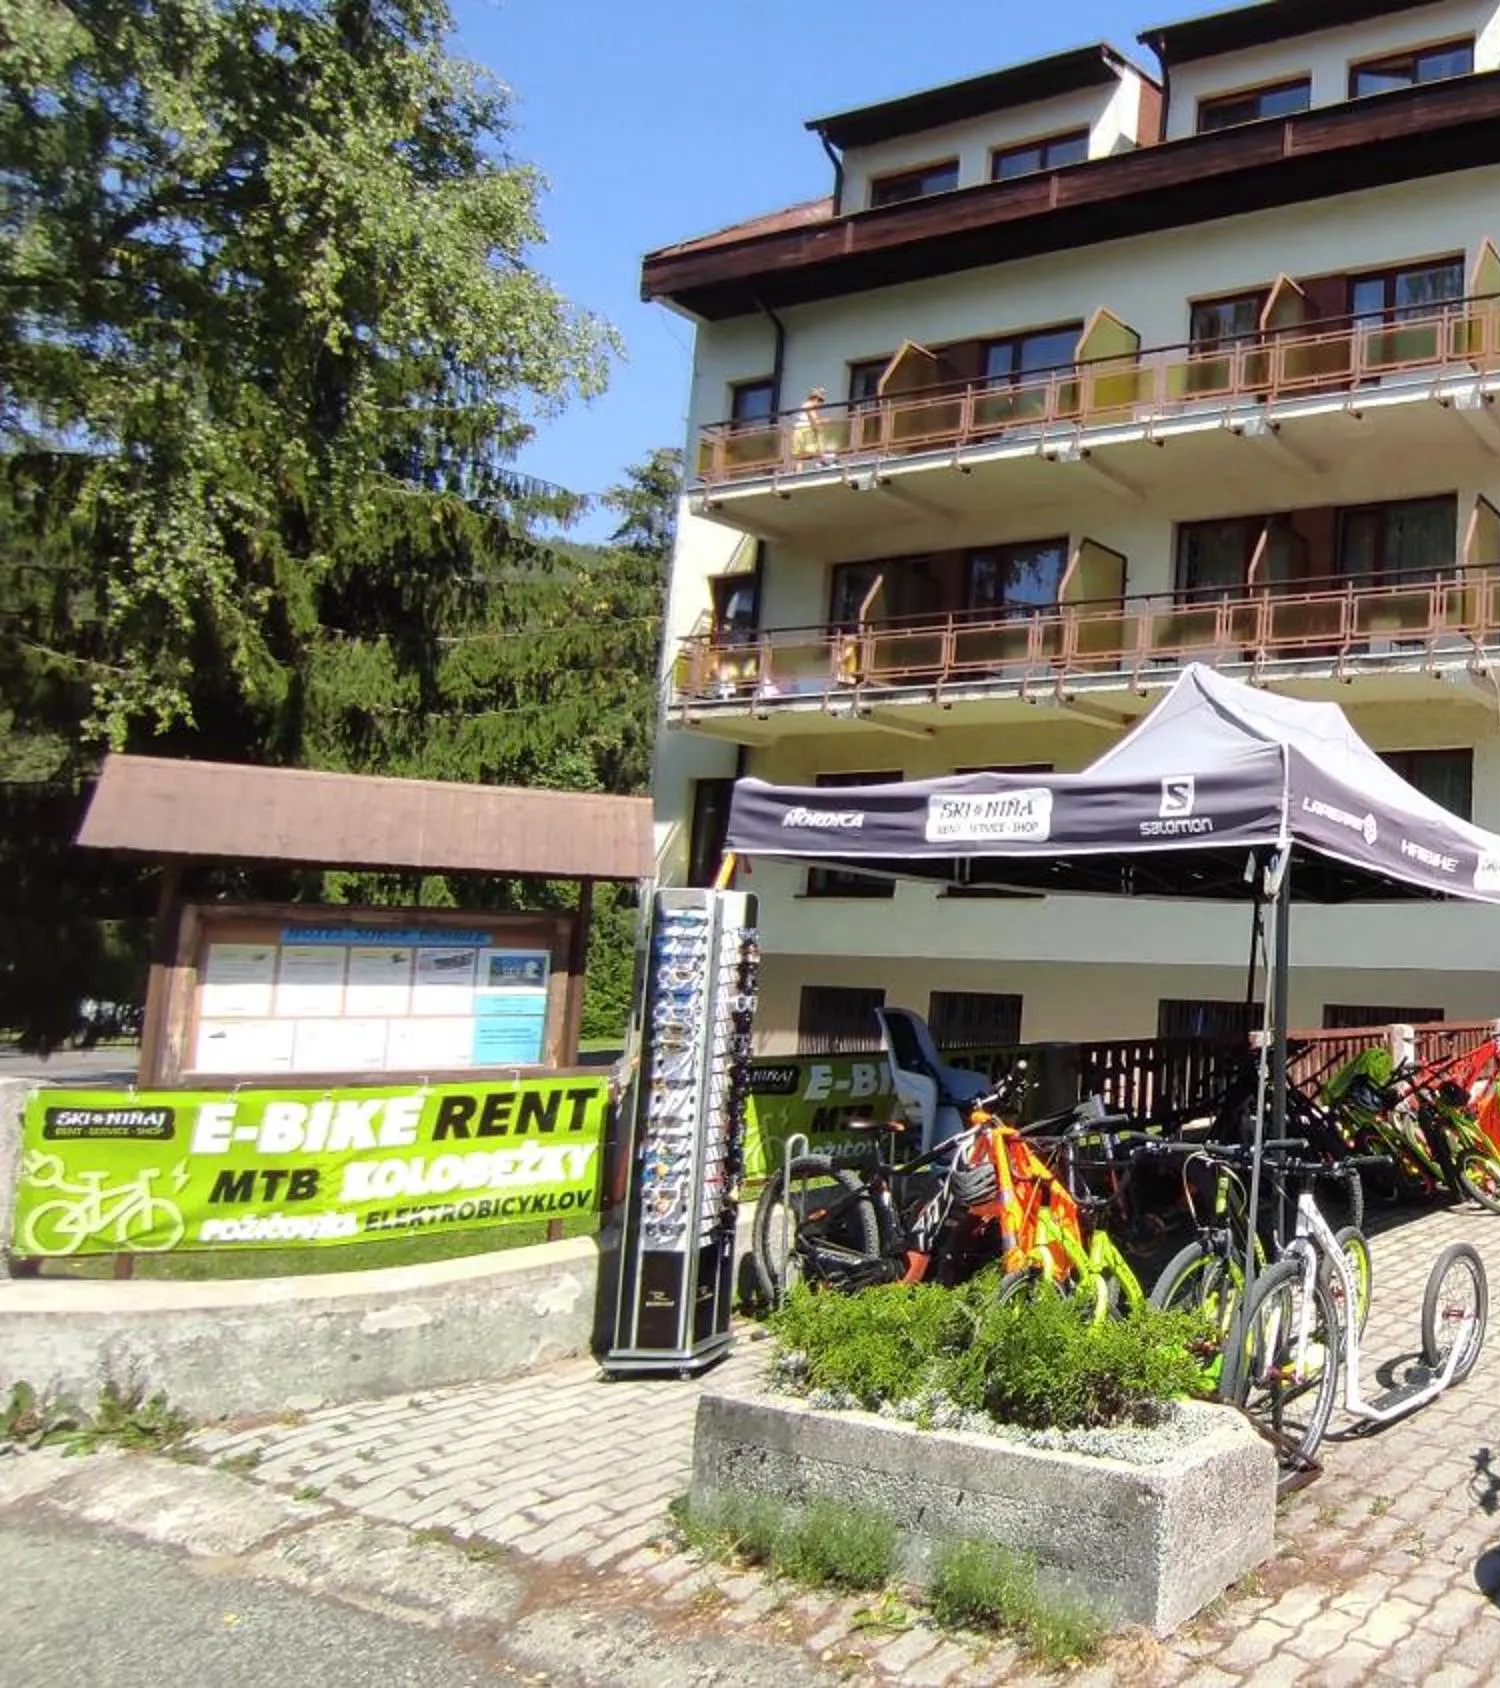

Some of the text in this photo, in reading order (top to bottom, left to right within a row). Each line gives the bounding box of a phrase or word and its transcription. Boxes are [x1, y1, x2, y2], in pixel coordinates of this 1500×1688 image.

[55, 1111, 89, 1126] SKI
[191, 1088, 599, 1153] E-BIKE RENT
[207, 1167, 320, 1204] MTB
